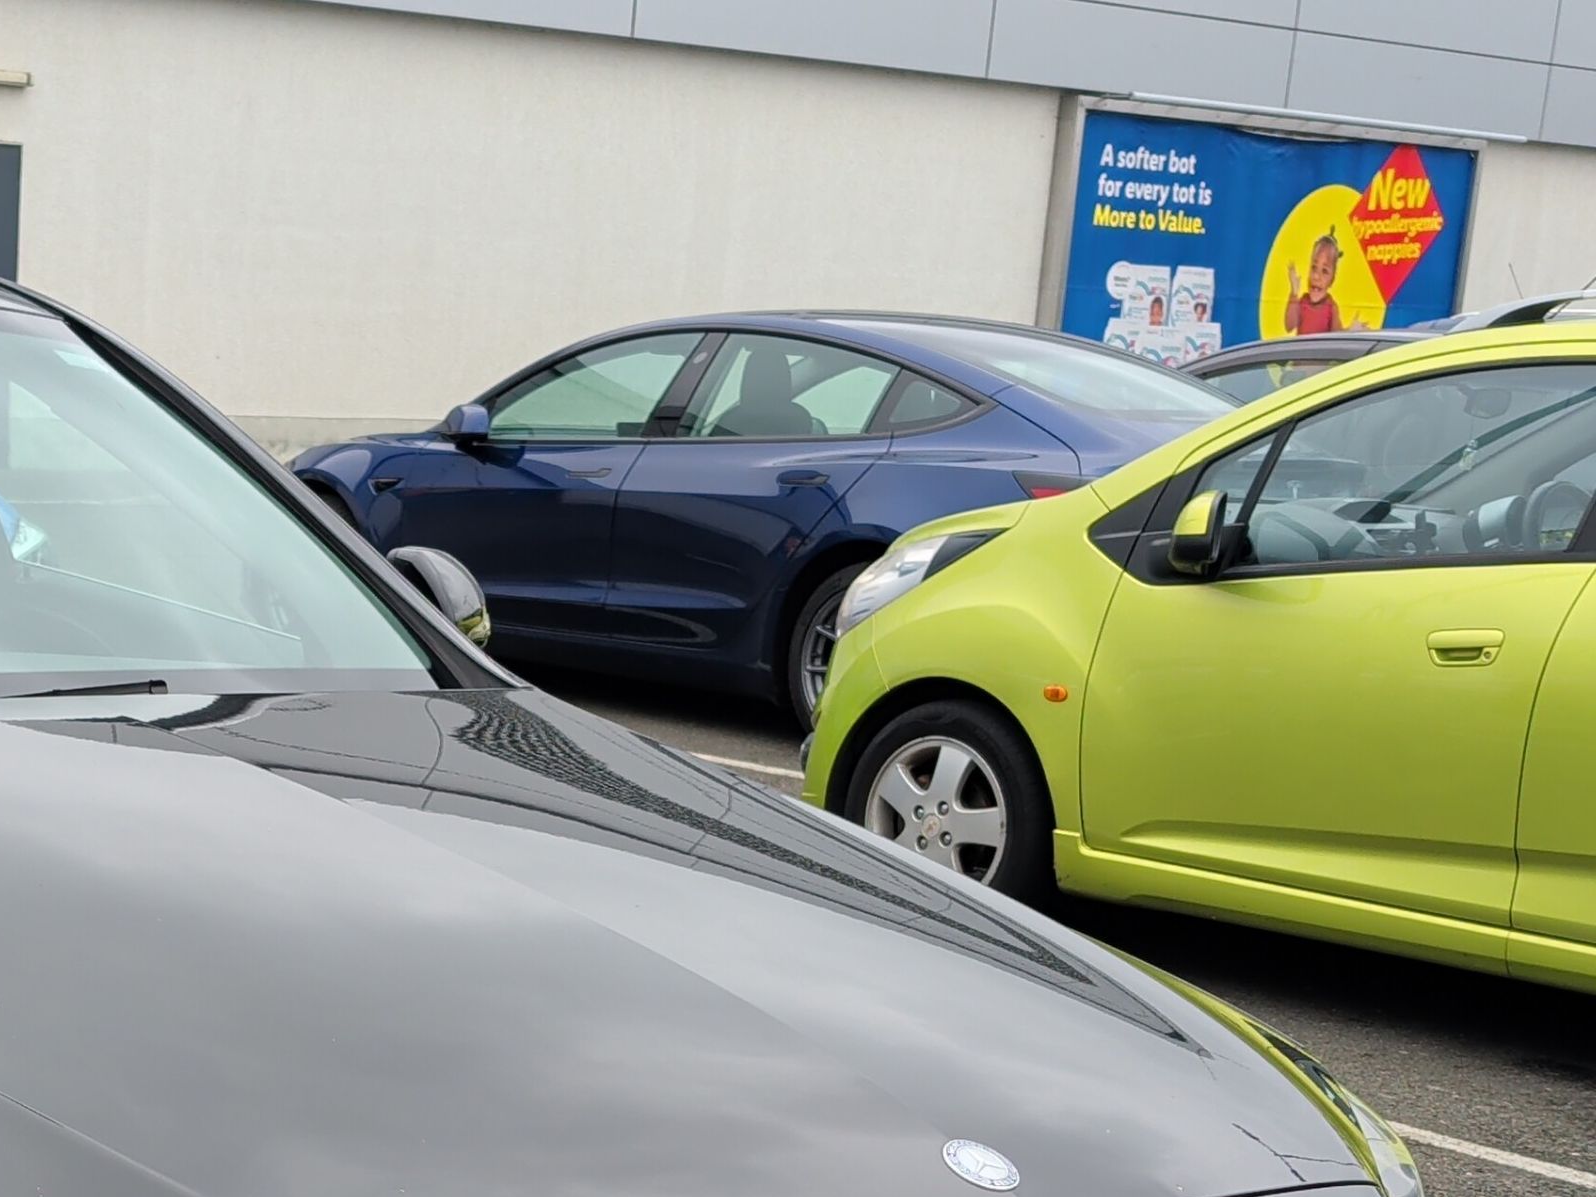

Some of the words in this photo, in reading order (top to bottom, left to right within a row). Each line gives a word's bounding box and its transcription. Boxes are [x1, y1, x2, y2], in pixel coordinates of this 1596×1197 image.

[1099, 143, 1114, 167] A
[1116, 146, 1166, 172] softer
[1168, 149, 1197, 175] bot
[1098, 172, 1123, 198] for
[1125, 181, 1170, 207] every
[1172, 182, 1196, 204] tot
[1198, 181, 1212, 206] is
[1367, 168, 1431, 211] New
[1093, 203, 1136, 229] More
[1138, 209, 1156, 230] to
[1158, 209, 1206, 234] Value.
[1366, 236, 1422, 265] nappies
